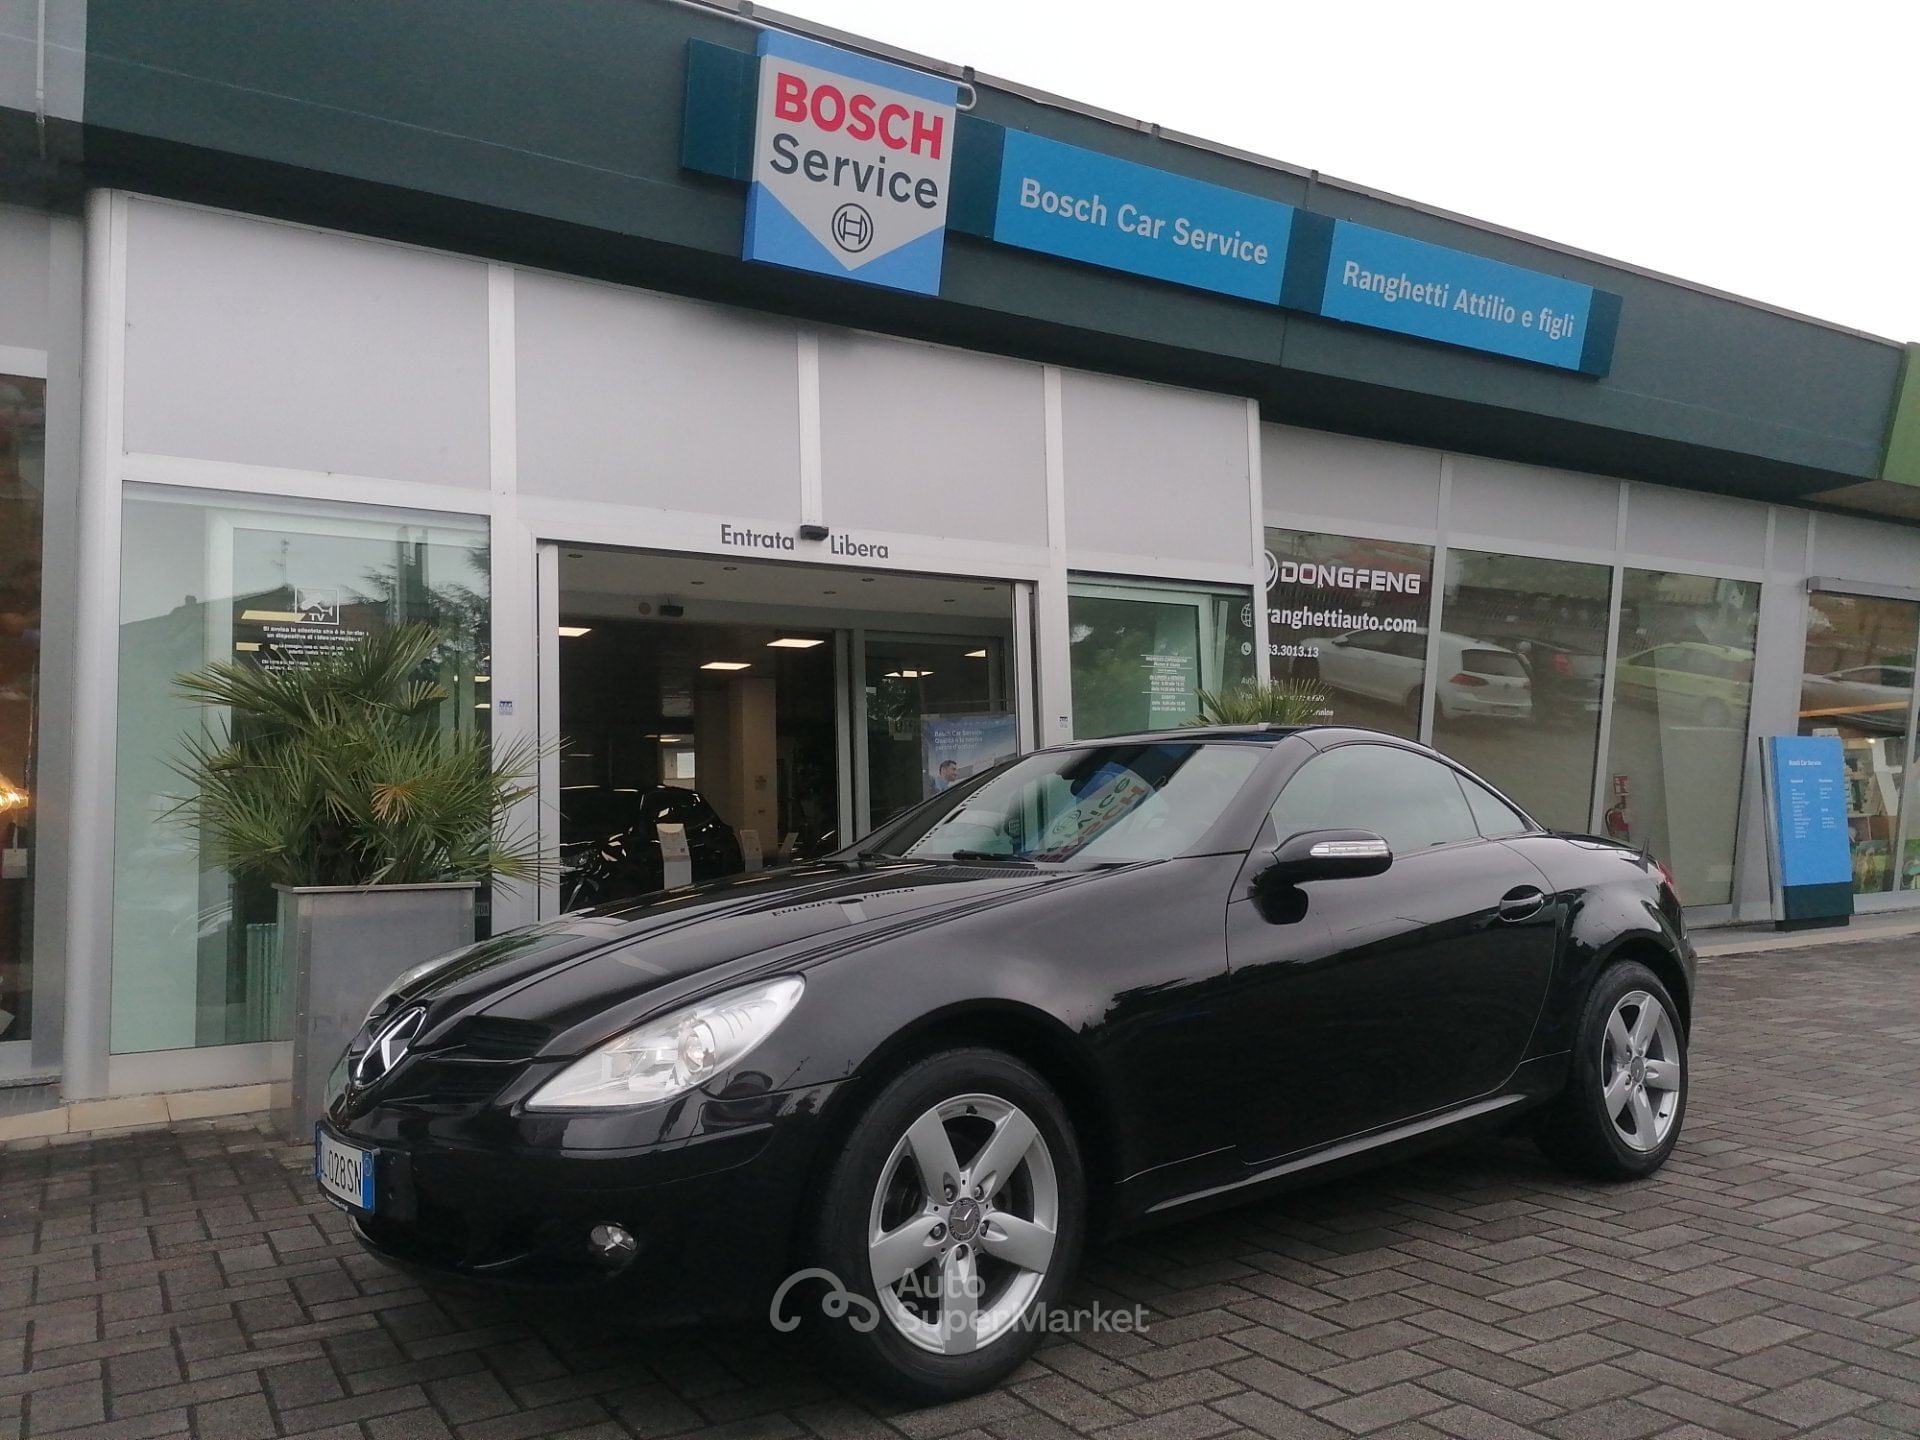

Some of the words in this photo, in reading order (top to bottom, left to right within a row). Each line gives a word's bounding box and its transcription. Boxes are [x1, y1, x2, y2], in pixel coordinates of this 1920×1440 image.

[775, 72, 944, 160] BOSCH
[769, 133, 938, 209] Service
[1020, 177, 1107, 228] Bosch
[1117, 203, 1166, 241] Car
[1173, 217, 1268, 267] Service
[1343, 260, 1449, 309] Ranghetti
[1453, 288, 1514, 325] Attilio
[1521, 312, 1532, 328] e
[1539, 307, 1574, 341] figli
[721, 523, 795, 550] Entrata
[830, 534, 889, 559] Libera
[1281, 561, 1421, 594] DONGFENG
[309, 613, 325, 621] TV
